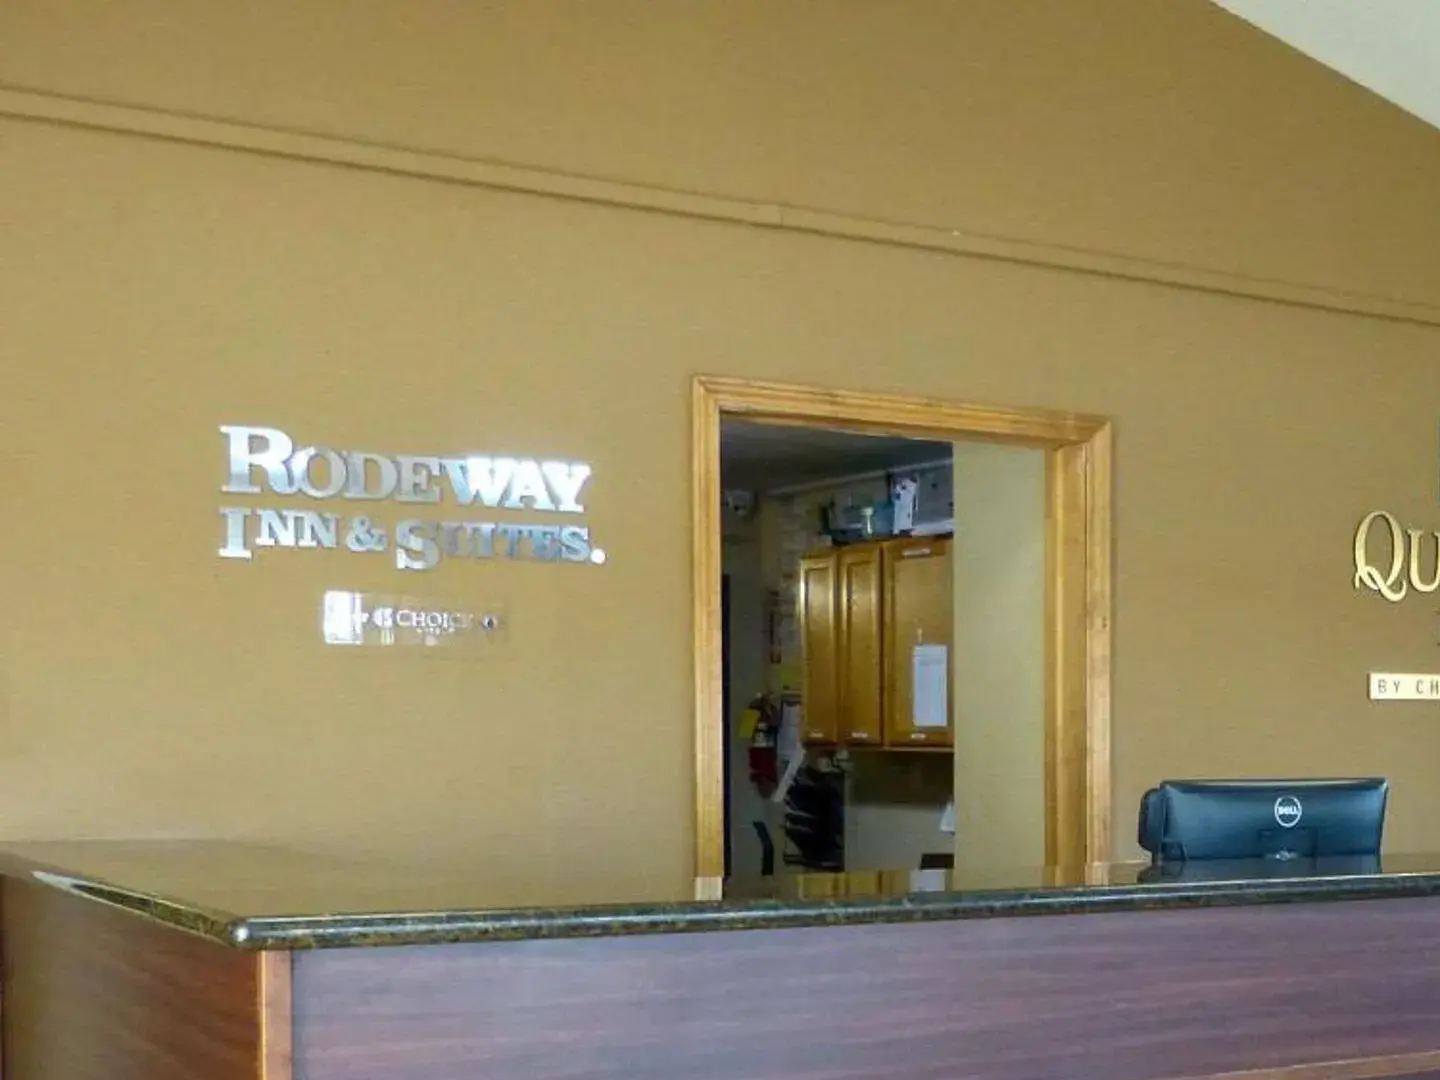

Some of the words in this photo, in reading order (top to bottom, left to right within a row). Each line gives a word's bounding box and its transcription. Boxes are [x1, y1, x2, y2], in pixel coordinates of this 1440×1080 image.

[219, 425, 592, 513] RODEWAY
[218, 507, 339, 558] INN
[346, 511, 388, 552] &
[1377, 679, 1402, 696] BY
[1278, 805, 1299, 815] DELL
